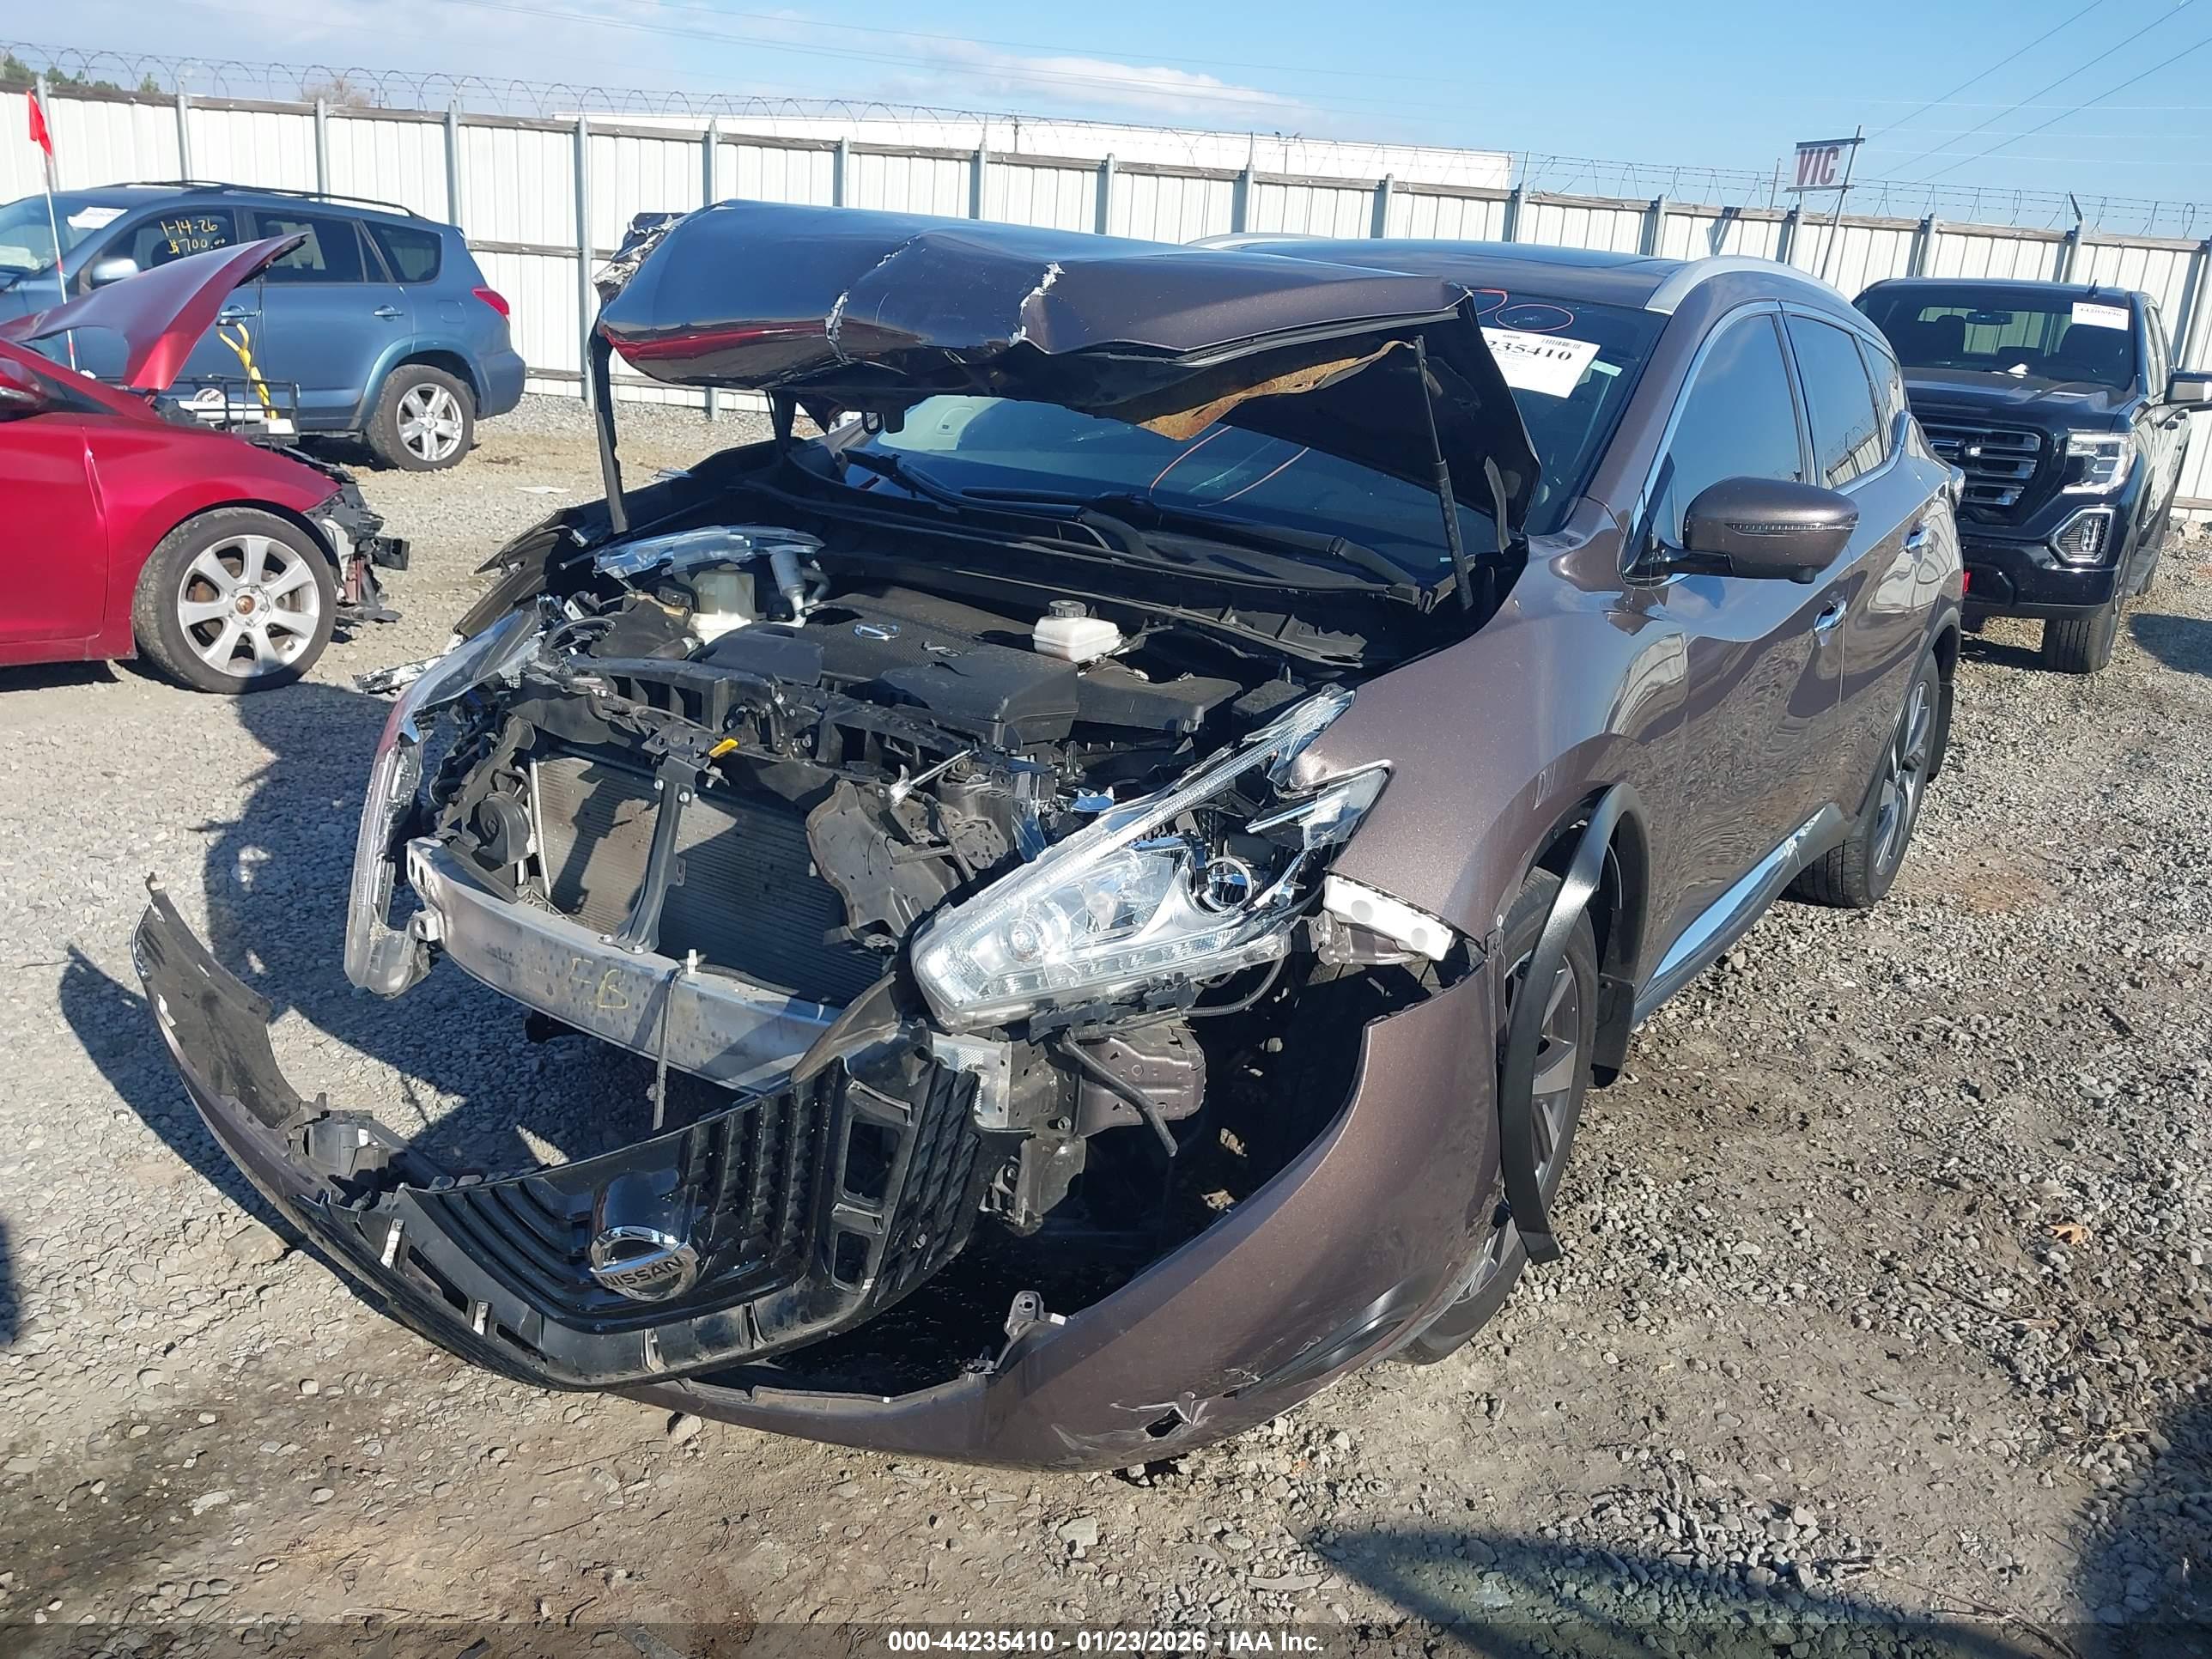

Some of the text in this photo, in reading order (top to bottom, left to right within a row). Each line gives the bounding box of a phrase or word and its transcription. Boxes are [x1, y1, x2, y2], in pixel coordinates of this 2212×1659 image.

[1796, 146, 1839, 186] VIC
[160, 218, 218, 237] 1-14-26
[599, 1255, 684, 1286] NISSAN
